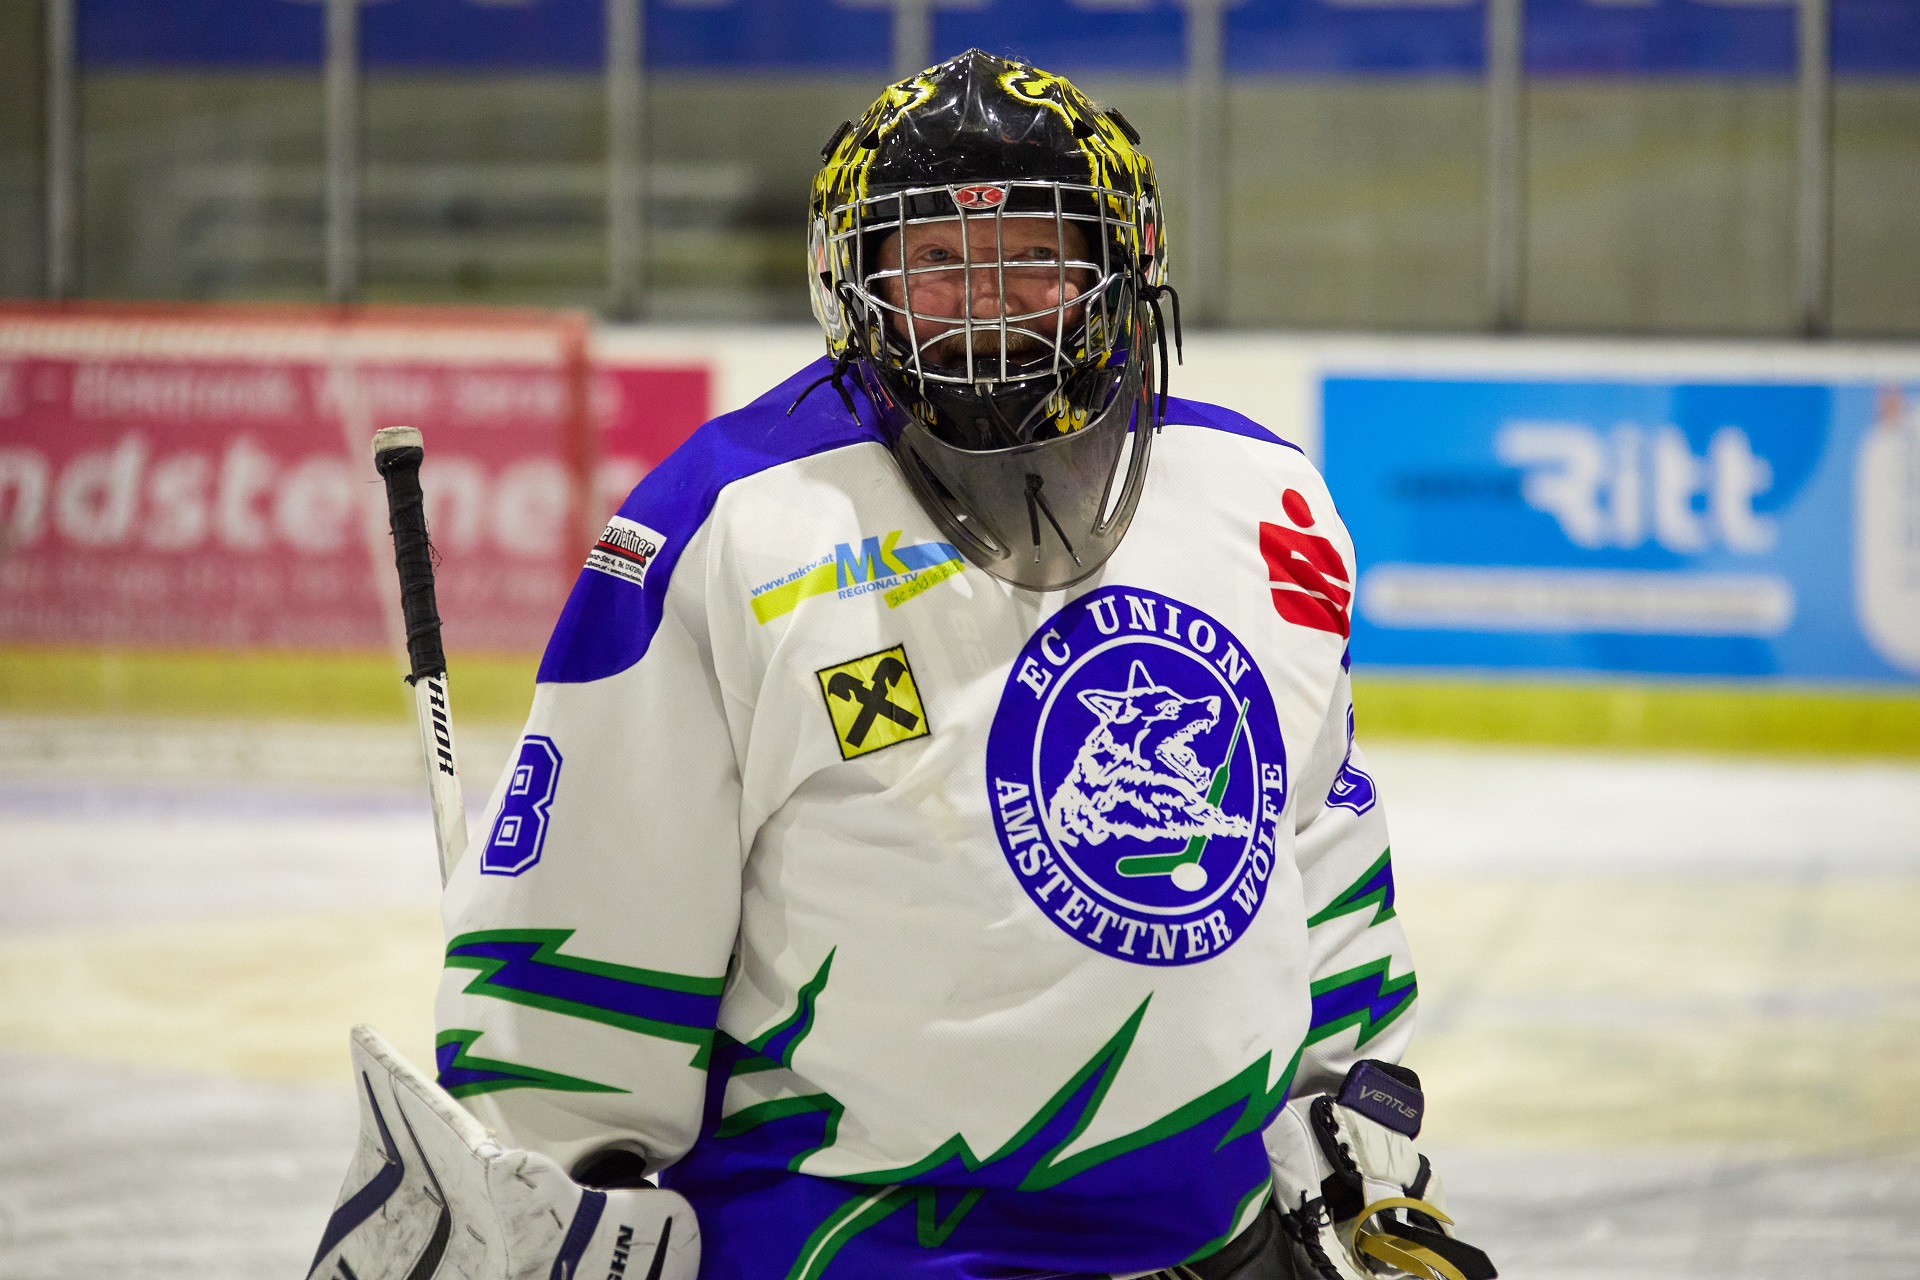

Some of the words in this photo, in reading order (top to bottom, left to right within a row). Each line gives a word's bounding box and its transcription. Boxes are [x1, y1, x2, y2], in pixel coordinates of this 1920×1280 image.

[1499, 421, 1777, 552] Ritt
[751, 553, 835, 597] www.mktv.at
[837, 576, 902, 600] REGIONAL
[902, 571, 919, 585] TV
[1016, 628, 1071, 700] EC
[1085, 594, 1252, 686] UNION
[427, 674, 455, 777] RIOR
[480, 734, 563, 877] 8
[995, 777, 1233, 961] AMSTETTNER
[1231, 762, 1283, 916] WÖLFE
[1360, 1085, 1418, 1119] VENTUS
